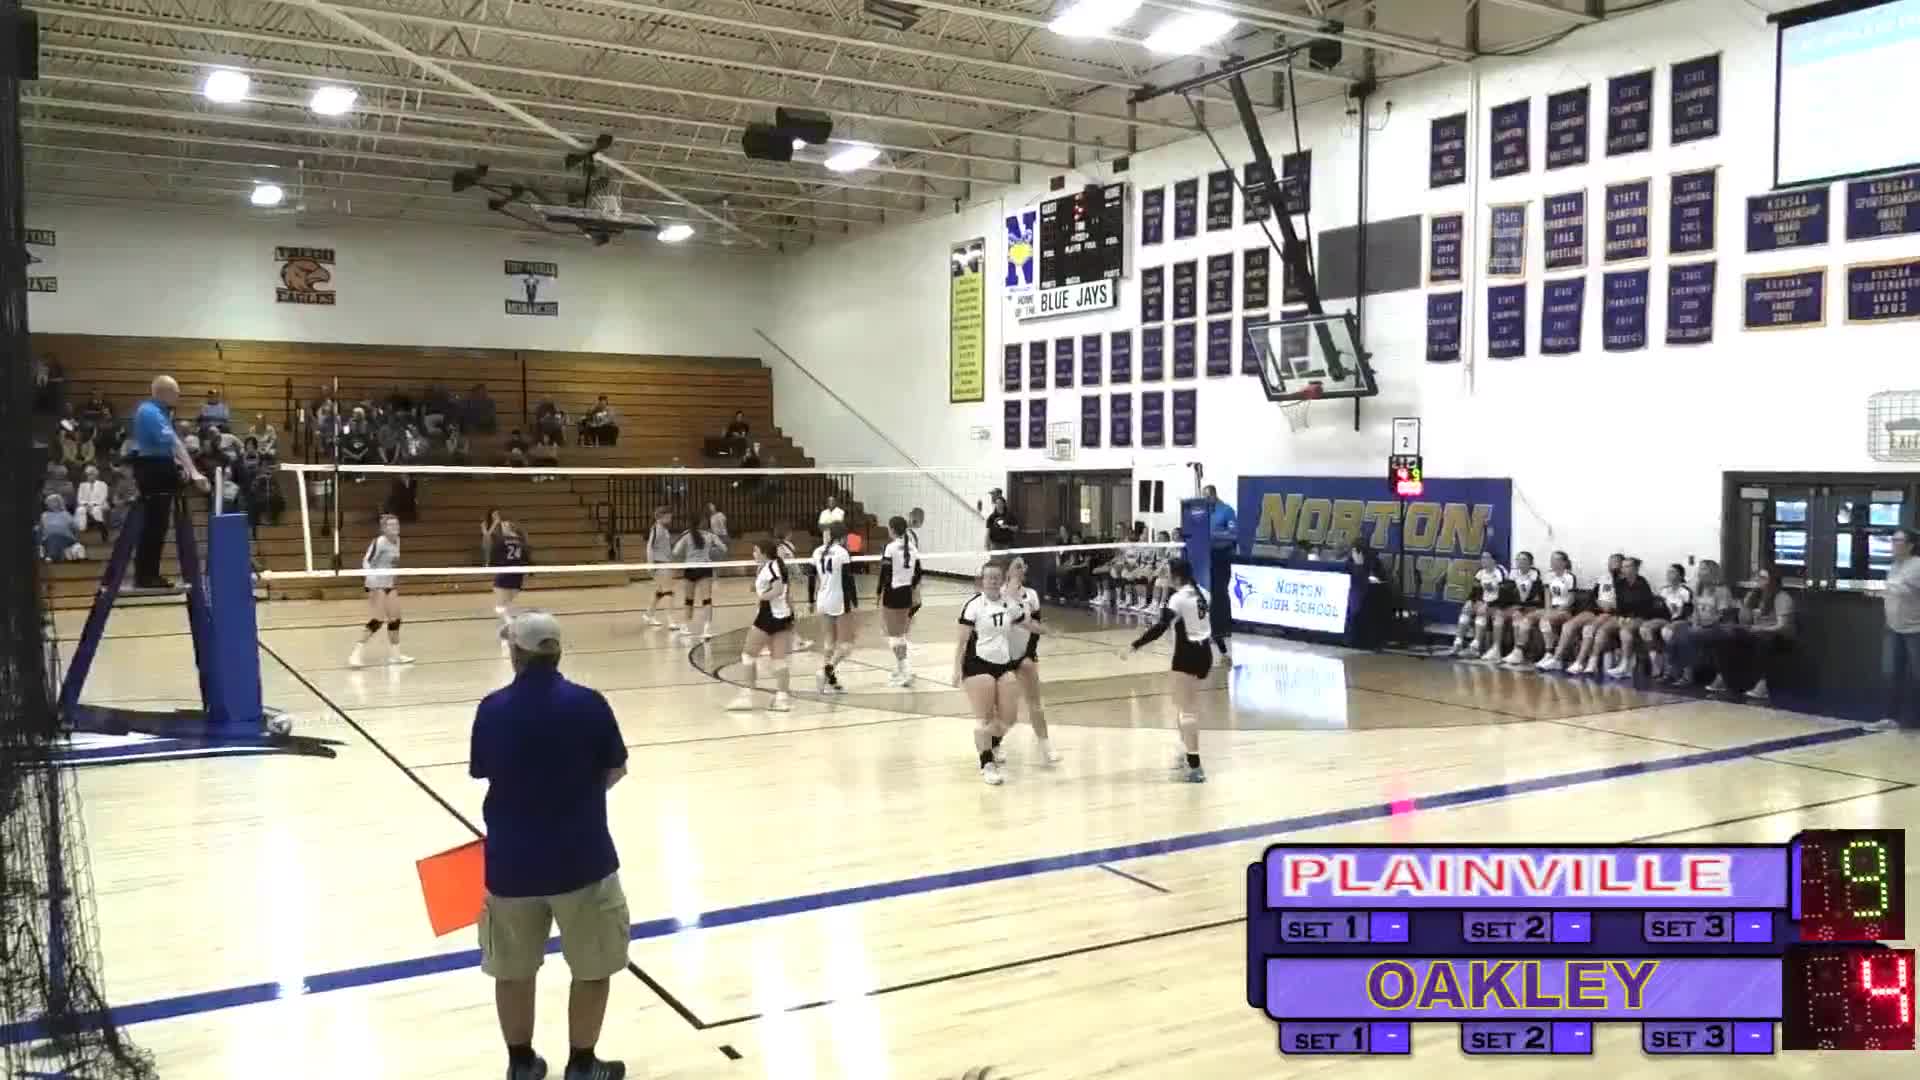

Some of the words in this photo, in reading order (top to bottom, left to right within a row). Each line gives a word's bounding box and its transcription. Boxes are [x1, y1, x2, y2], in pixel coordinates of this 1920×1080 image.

[1041, 289, 1069, 313] BLUE
[1076, 284, 1107, 308] JAYS
[1254, 492, 1493, 555] NORTON
[1276, 577, 1324, 599] NORTON
